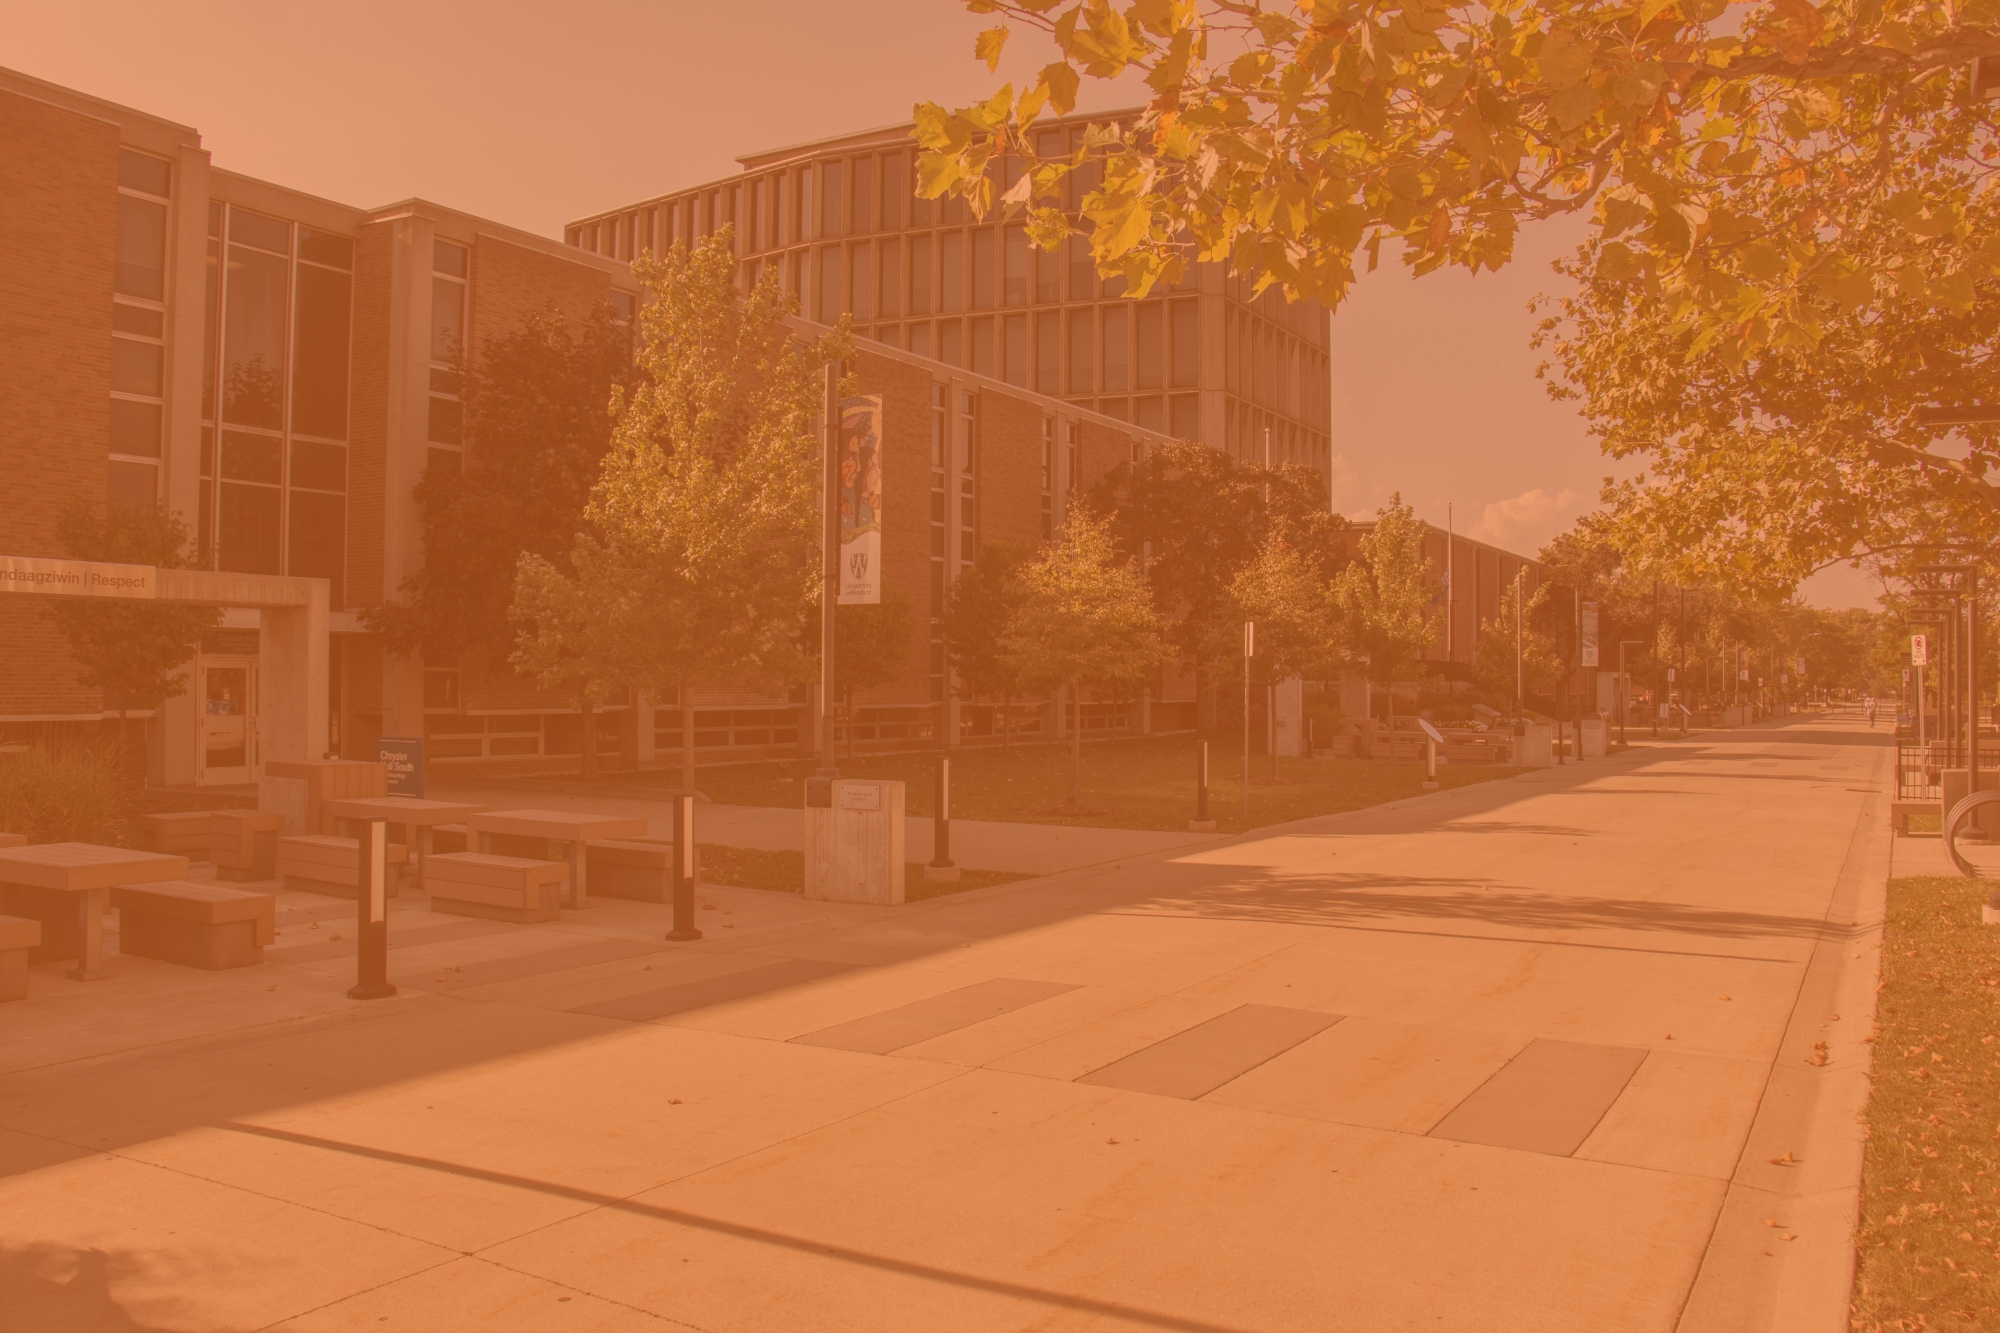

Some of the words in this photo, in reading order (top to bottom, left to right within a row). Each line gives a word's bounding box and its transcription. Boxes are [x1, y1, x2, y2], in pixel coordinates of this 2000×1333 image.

[91, 573, 146, 590] Respect
[218, 634, 245, 643] Chrysler
[380, 750, 408, 763] Chrysler
[394, 761, 414, 772] South
